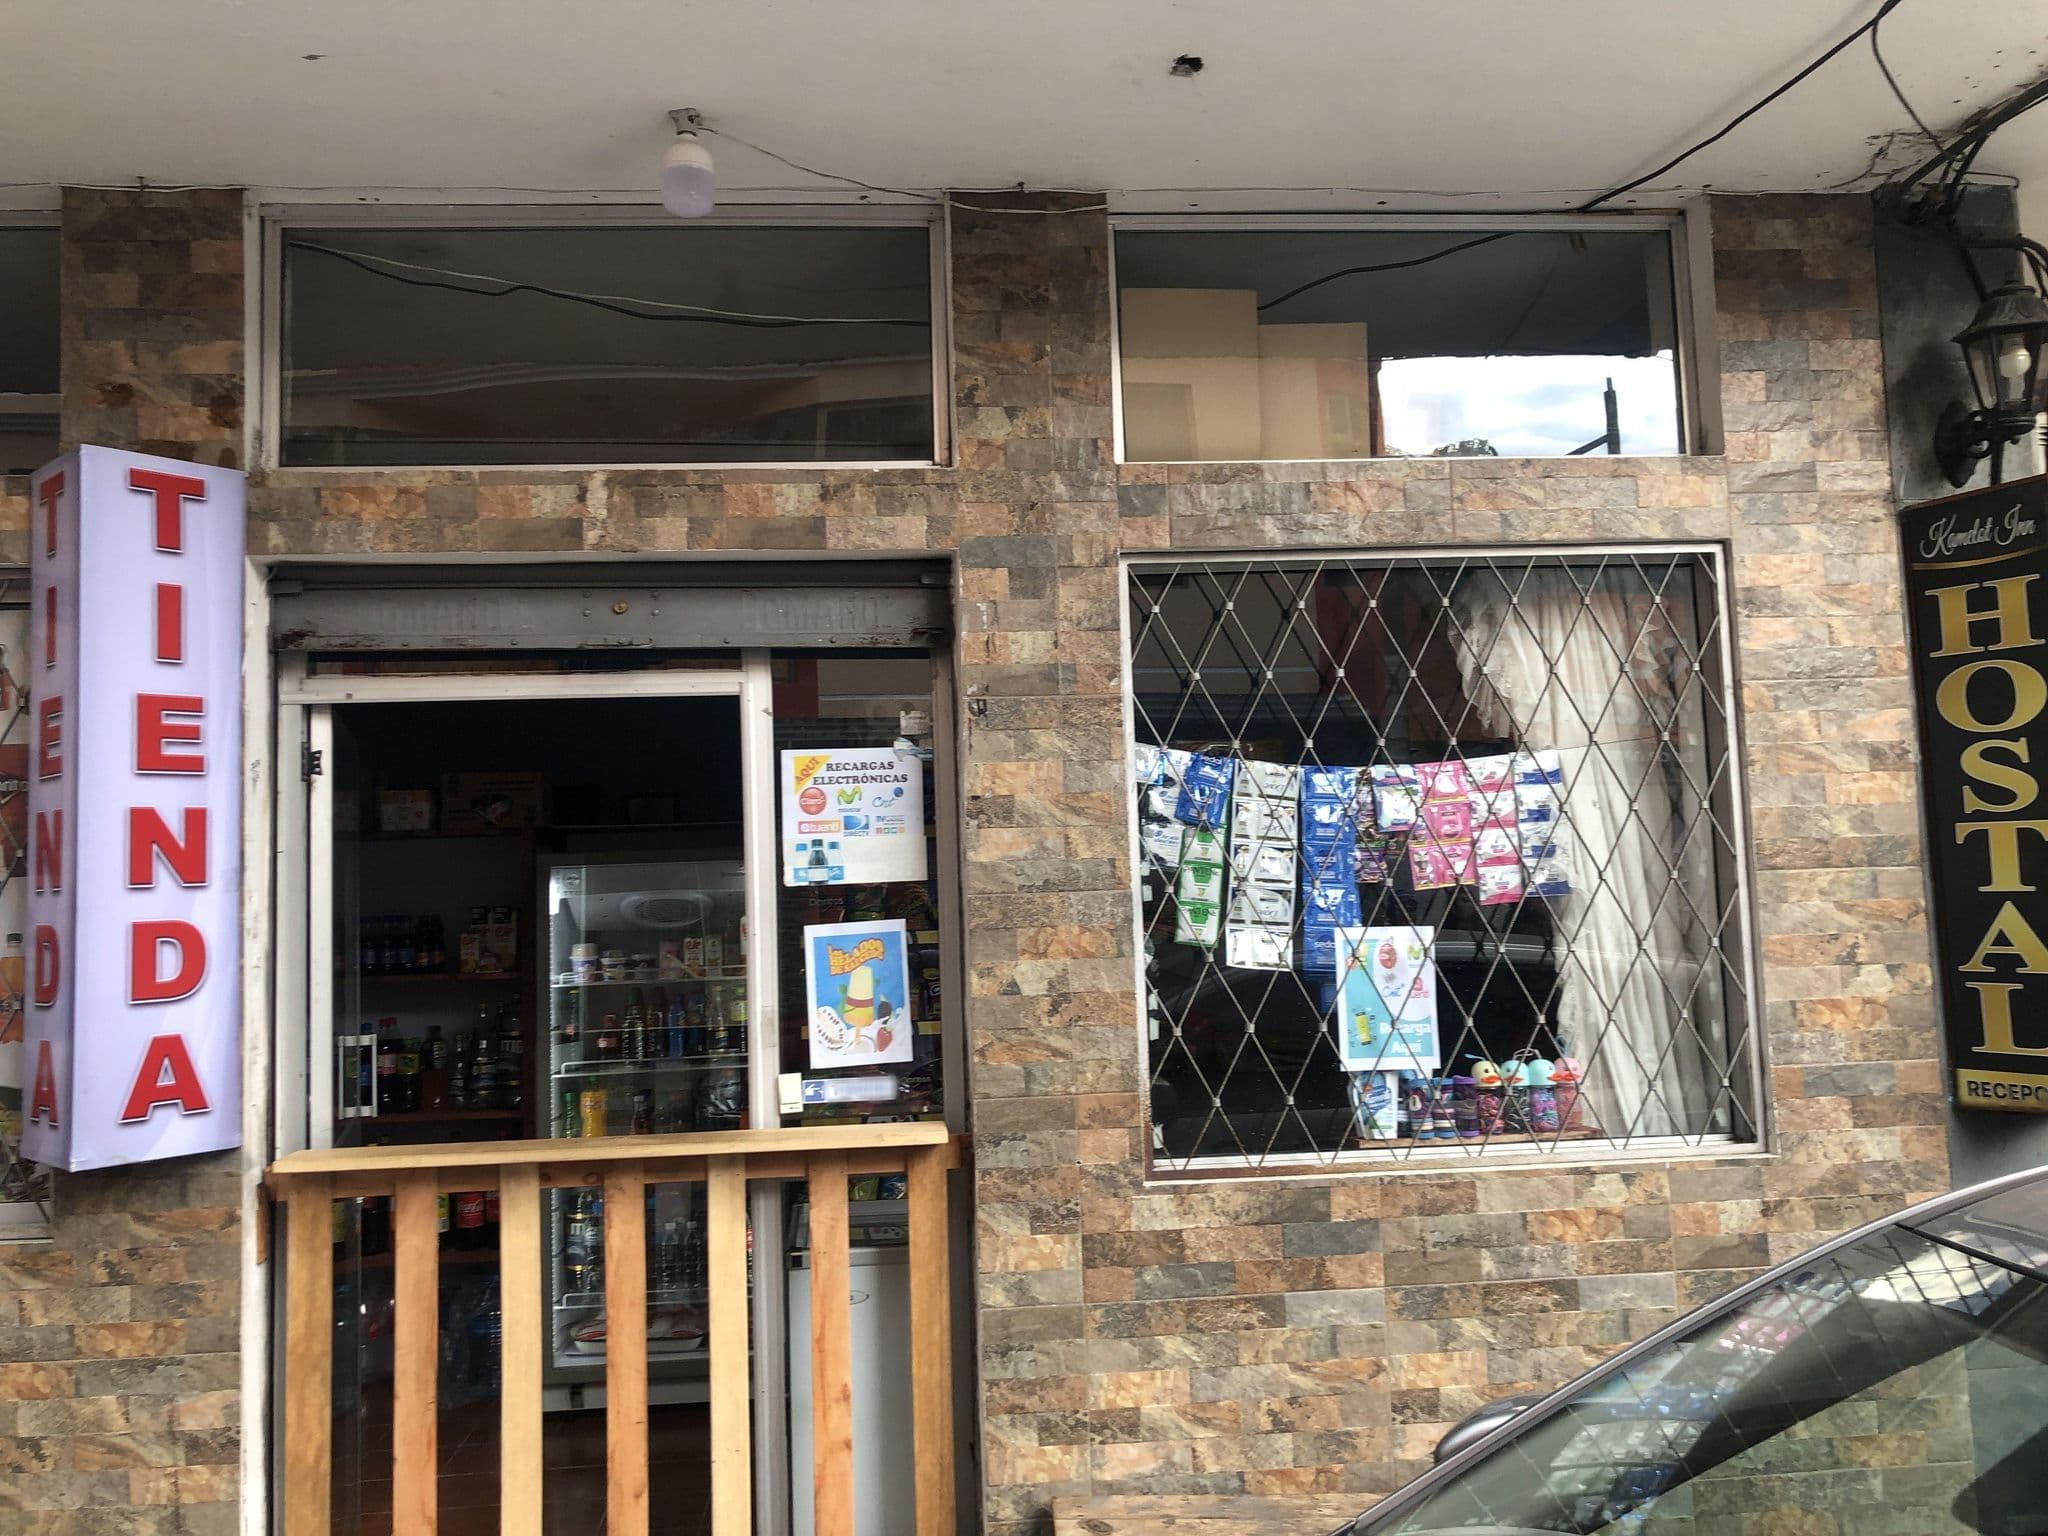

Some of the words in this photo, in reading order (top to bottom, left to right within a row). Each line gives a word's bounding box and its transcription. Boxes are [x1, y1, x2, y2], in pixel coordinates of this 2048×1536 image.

[1994, 503, 2037, 546] Inn
[31, 471, 64, 1127] TIENDA
[118, 468, 212, 1124] TIENDA
[812, 773, 908, 786] ELECTRÓNICAS
[826, 761, 895, 772] RECARGAS
[1924, 573, 2048, 1057] HOSTAL
